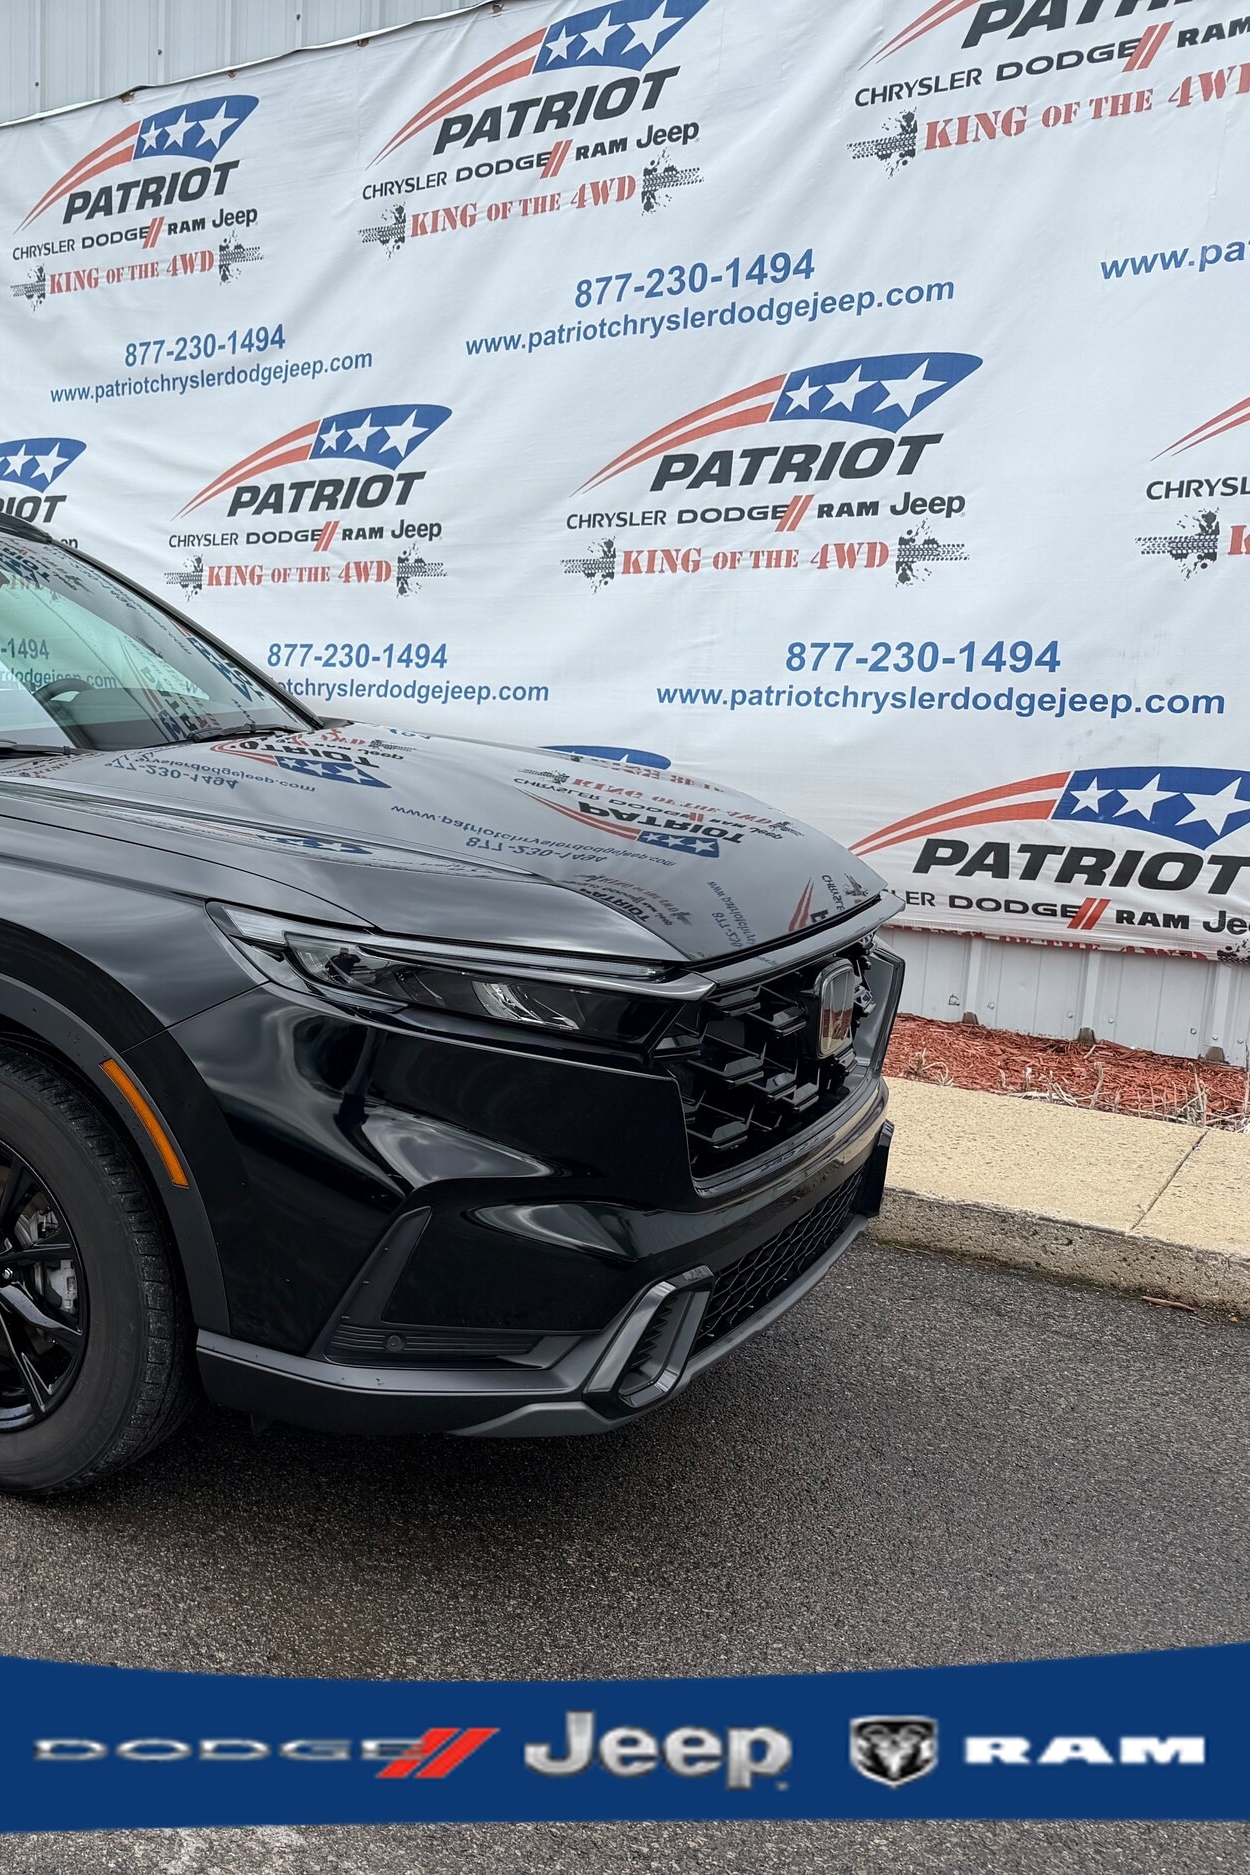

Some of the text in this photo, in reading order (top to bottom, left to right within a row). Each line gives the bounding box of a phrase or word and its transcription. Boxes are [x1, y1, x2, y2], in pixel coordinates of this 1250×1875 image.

[854, 67, 983, 107] CHRYSLER
[996, 37, 1142, 82] DODGE
[1177, 16, 1250, 48] RAM
[433, 66, 681, 156] PATRIOT
[924, 105, 1028, 151] KING
[1041, 102, 1081, 128] OF
[1088, 88, 1154, 120] THE
[362, 120, 700, 200] CHRYSLER DODGE RAM Jeep
[63, 159, 241, 225] PATRIOT
[410, 174, 637, 238] KING OF THE 4WD
[12, 206, 258, 261] CHRYSLER DODGE RAM Jeep
[49, 249, 215, 295] KING OF THE 4WD
[574, 248, 815, 309] 877-230-1494
[1100, 239, 1250, 280] www.pa
[465, 279, 955, 356] www.patriotchryslerdodgejeep.com
[124, 323, 286, 367] 877-230-1494
[50, 352, 373, 403] www.patriotchryslerdodgejeep.com
[649, 433, 944, 492] PATRIOT
[227, 470, 426, 518] PATRIOT
[566, 491, 966, 530] CHRYSLER DODGE RAM Jeep
[168, 518, 443, 549] CHRYSLER DODGE RAM Jeep
[207, 560, 392, 587] KING OF THE 4WD
[620, 541, 889, 576] KING OF THE 4WD
[267, 642, 447, 669] 877-230-1494
[785, 640, 1061, 673] 877-230-1494
[276, 677, 549, 704] otchryslerdodgejeep.com
[657, 685, 1225, 719] www.patriotchryslerdodgejeep.com
[912, 838, 1250, 895] PATRIOT
[949, 895, 1081, 919] DODGE
[1116, 910, 1190, 930] RAM
[1203, 910, 1250, 935] Je
